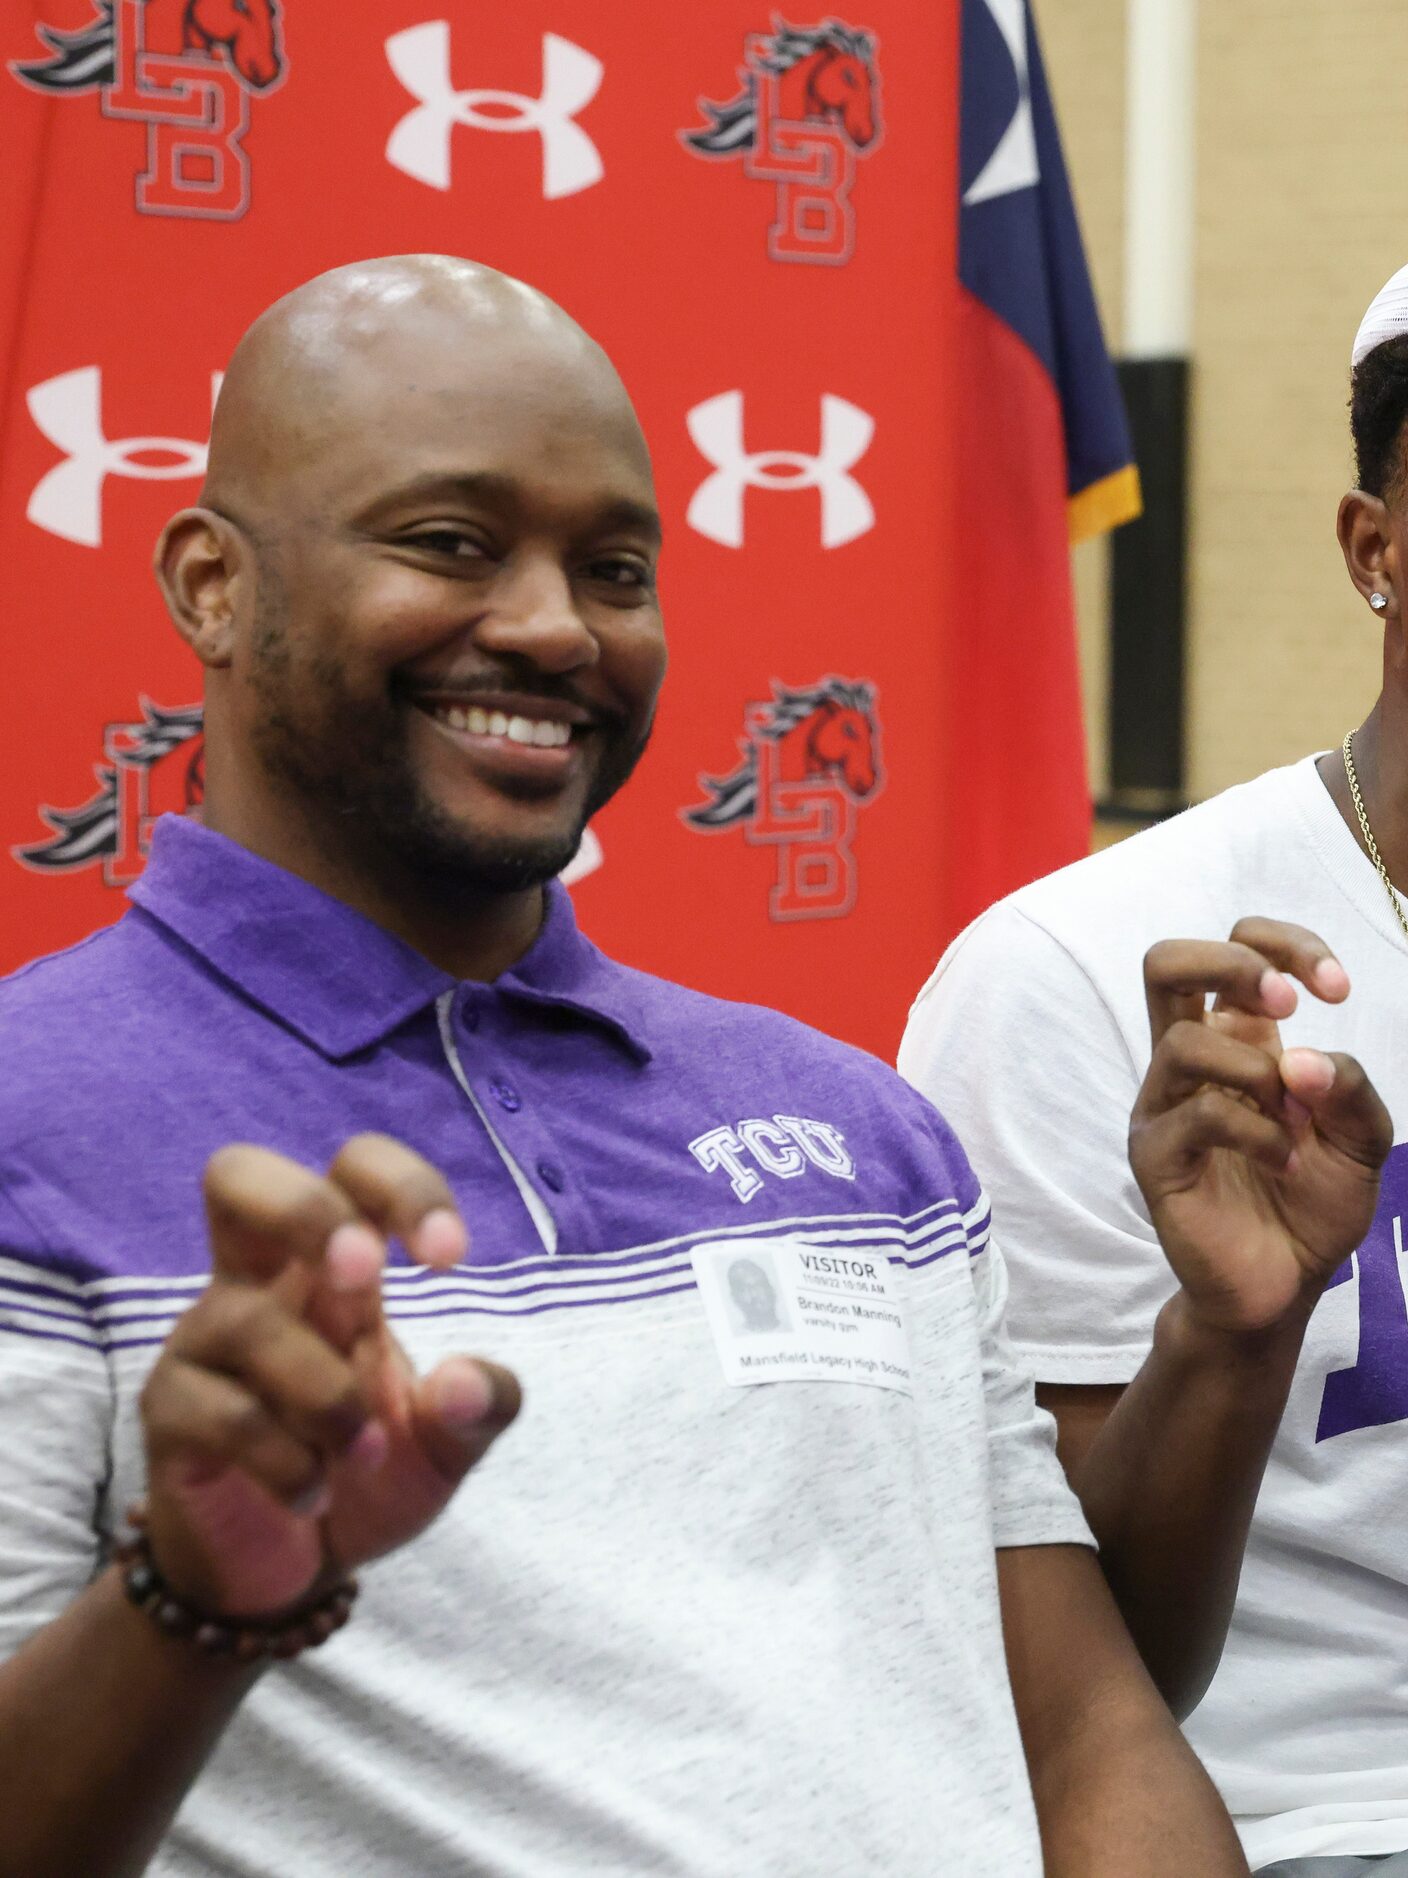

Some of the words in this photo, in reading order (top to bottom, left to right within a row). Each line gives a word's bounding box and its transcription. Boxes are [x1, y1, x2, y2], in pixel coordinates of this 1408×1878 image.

[688, 1114, 856, 1204] TCU
[799, 1253, 877, 1279] VISITOR
[797, 1296, 849, 1316] Brandon
[852, 1305, 902, 1328] Manning
[740, 1352, 808, 1369] Mansfield
[811, 1353, 852, 1369] Legacy
[854, 1357, 879, 1372] High
